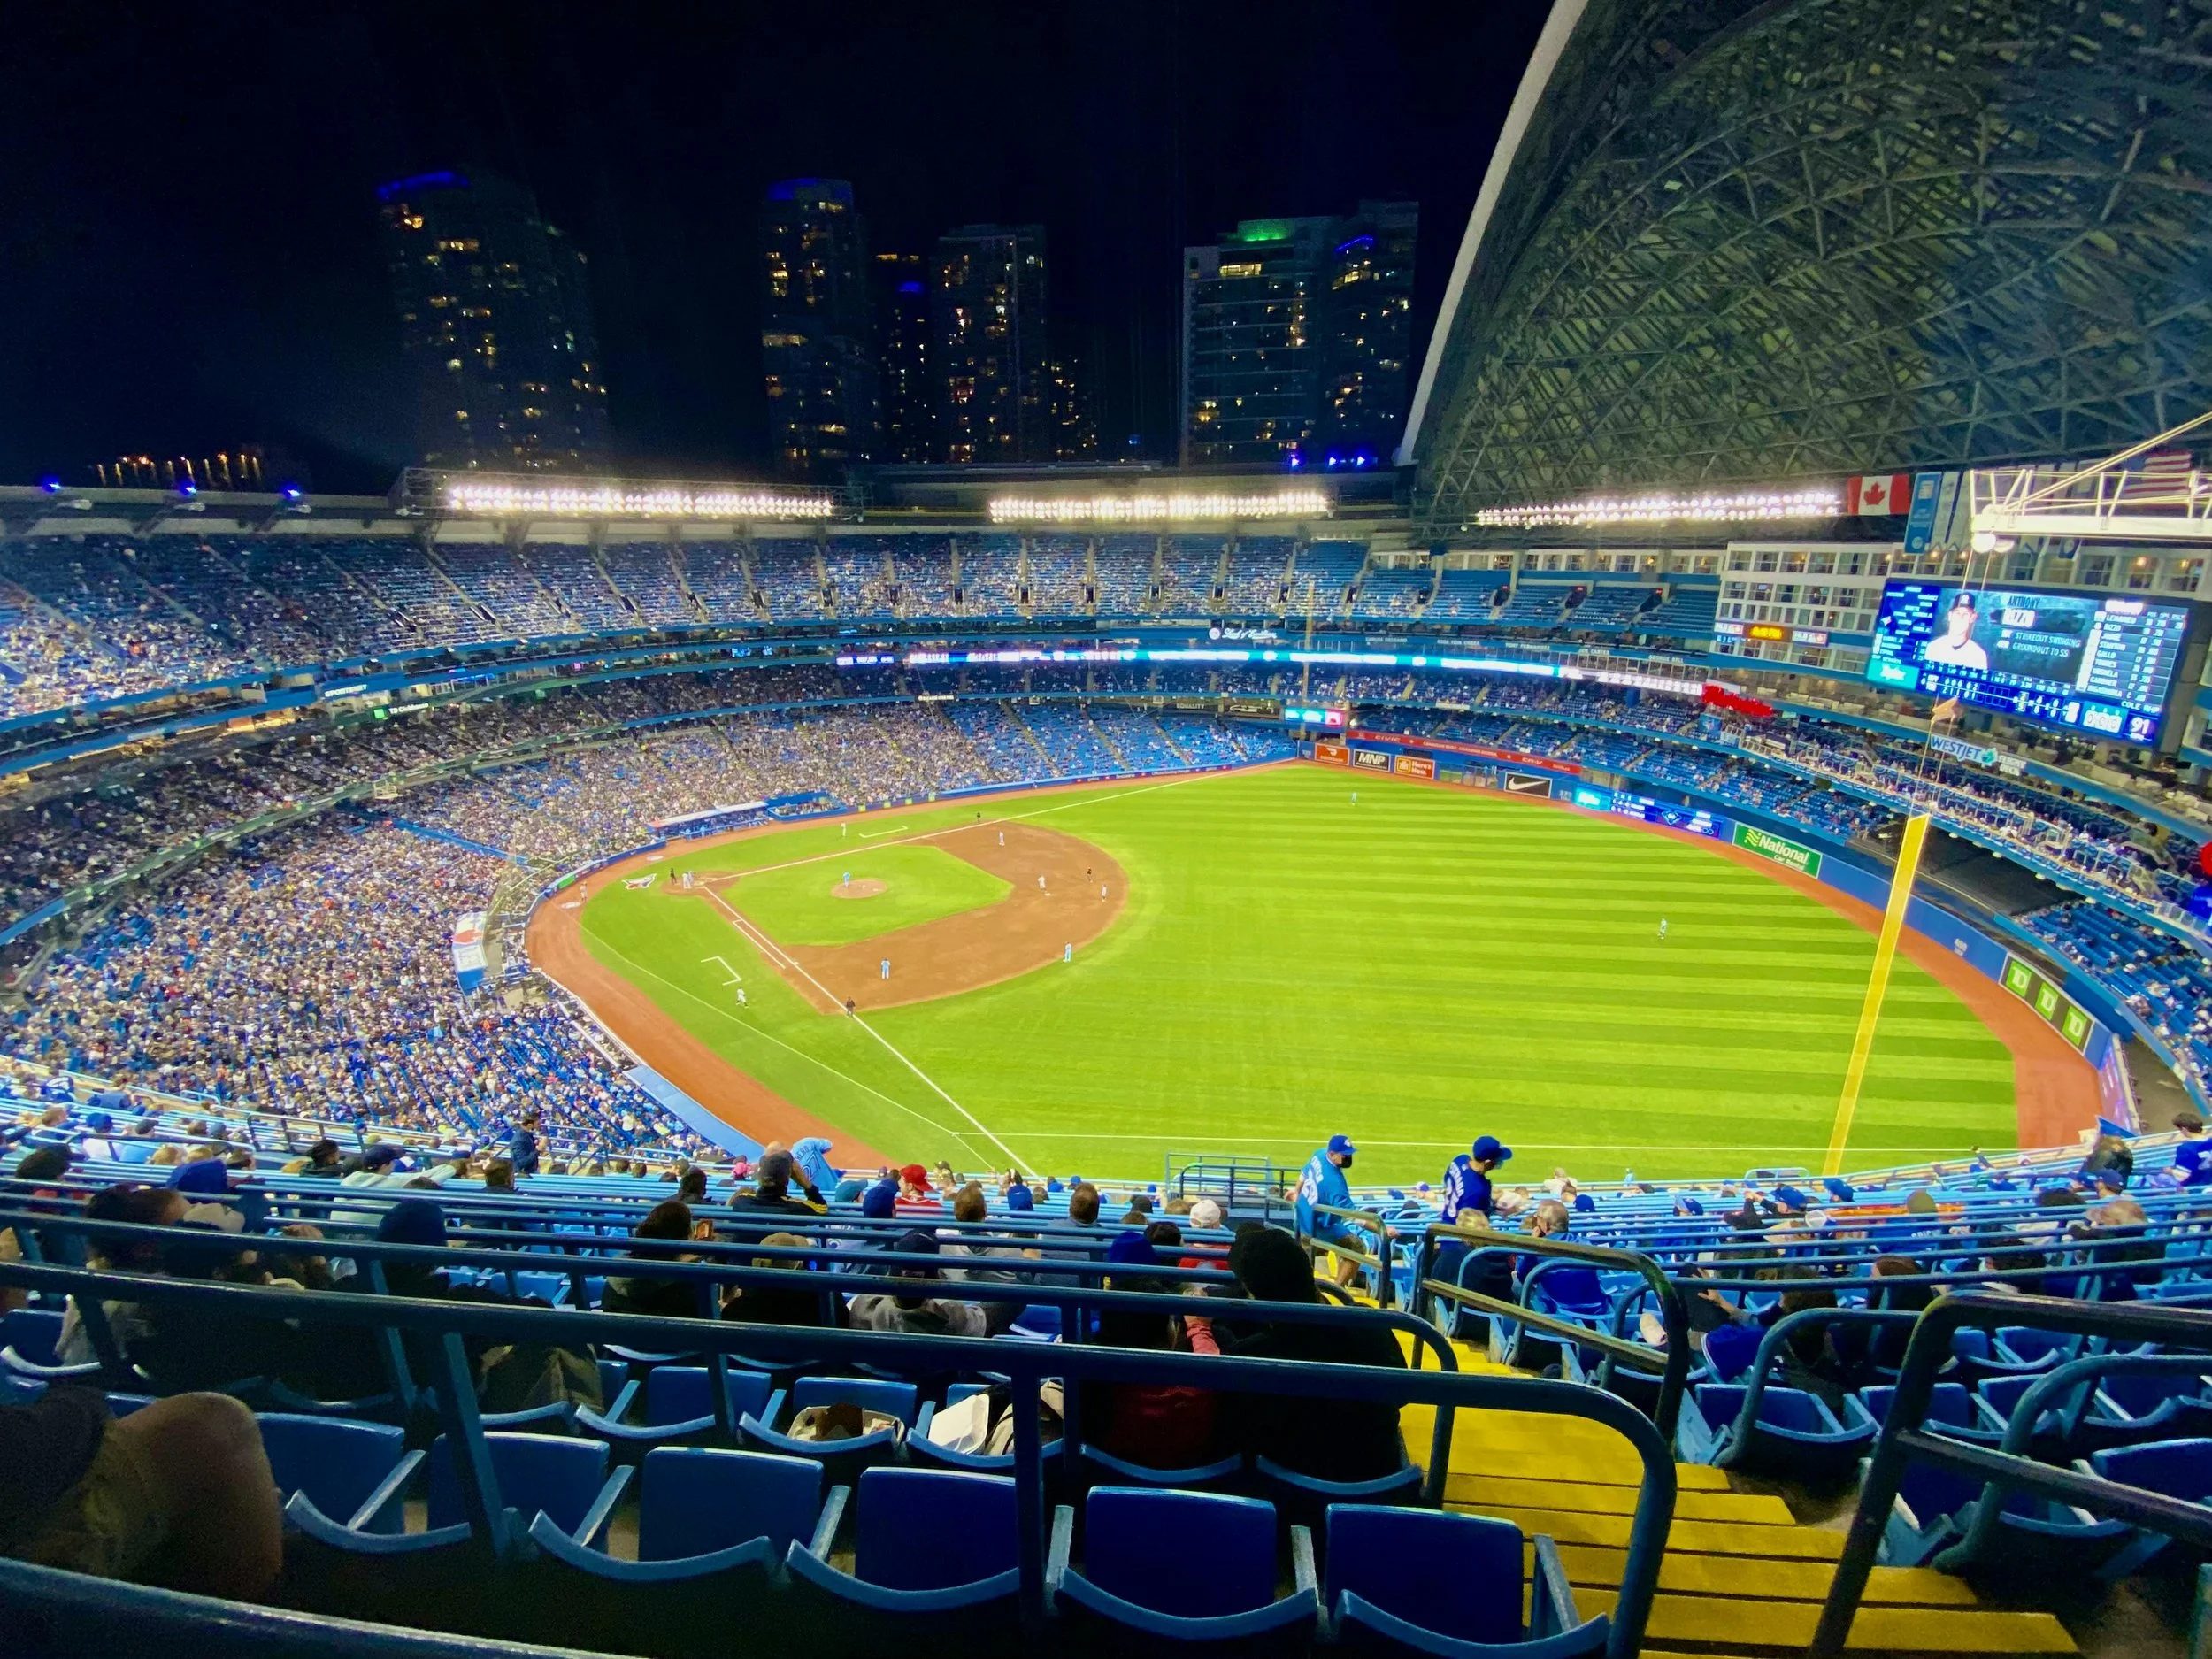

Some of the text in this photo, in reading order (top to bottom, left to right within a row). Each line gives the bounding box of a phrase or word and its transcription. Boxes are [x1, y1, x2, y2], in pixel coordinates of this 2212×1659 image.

[2007, 595, 2041, 609] ANTHONY
[2016, 632, 2048, 643] STRIKEOUT
[2048, 636, 2082, 648] SWINGING
[2012, 642, 2050, 655] GROUNDOUT
[2059, 649, 2069, 657] SS
[2121, 700, 2141, 710] COLE
[2131, 717, 2150, 734] 91
[1932, 735, 1981, 761] WESTJET
[1358, 752, 1386, 765] MNP
[1411, 761, 1432, 771] Here's
[1522, 757, 1543, 765] CR-V
[1759, 835, 1809, 865] National
[2011, 964, 2028, 989] TD
[2040, 987, 2055, 1010] TD
[2068, 1011, 2084, 1034] TD
[802, 1151, 821, 1182] 27
